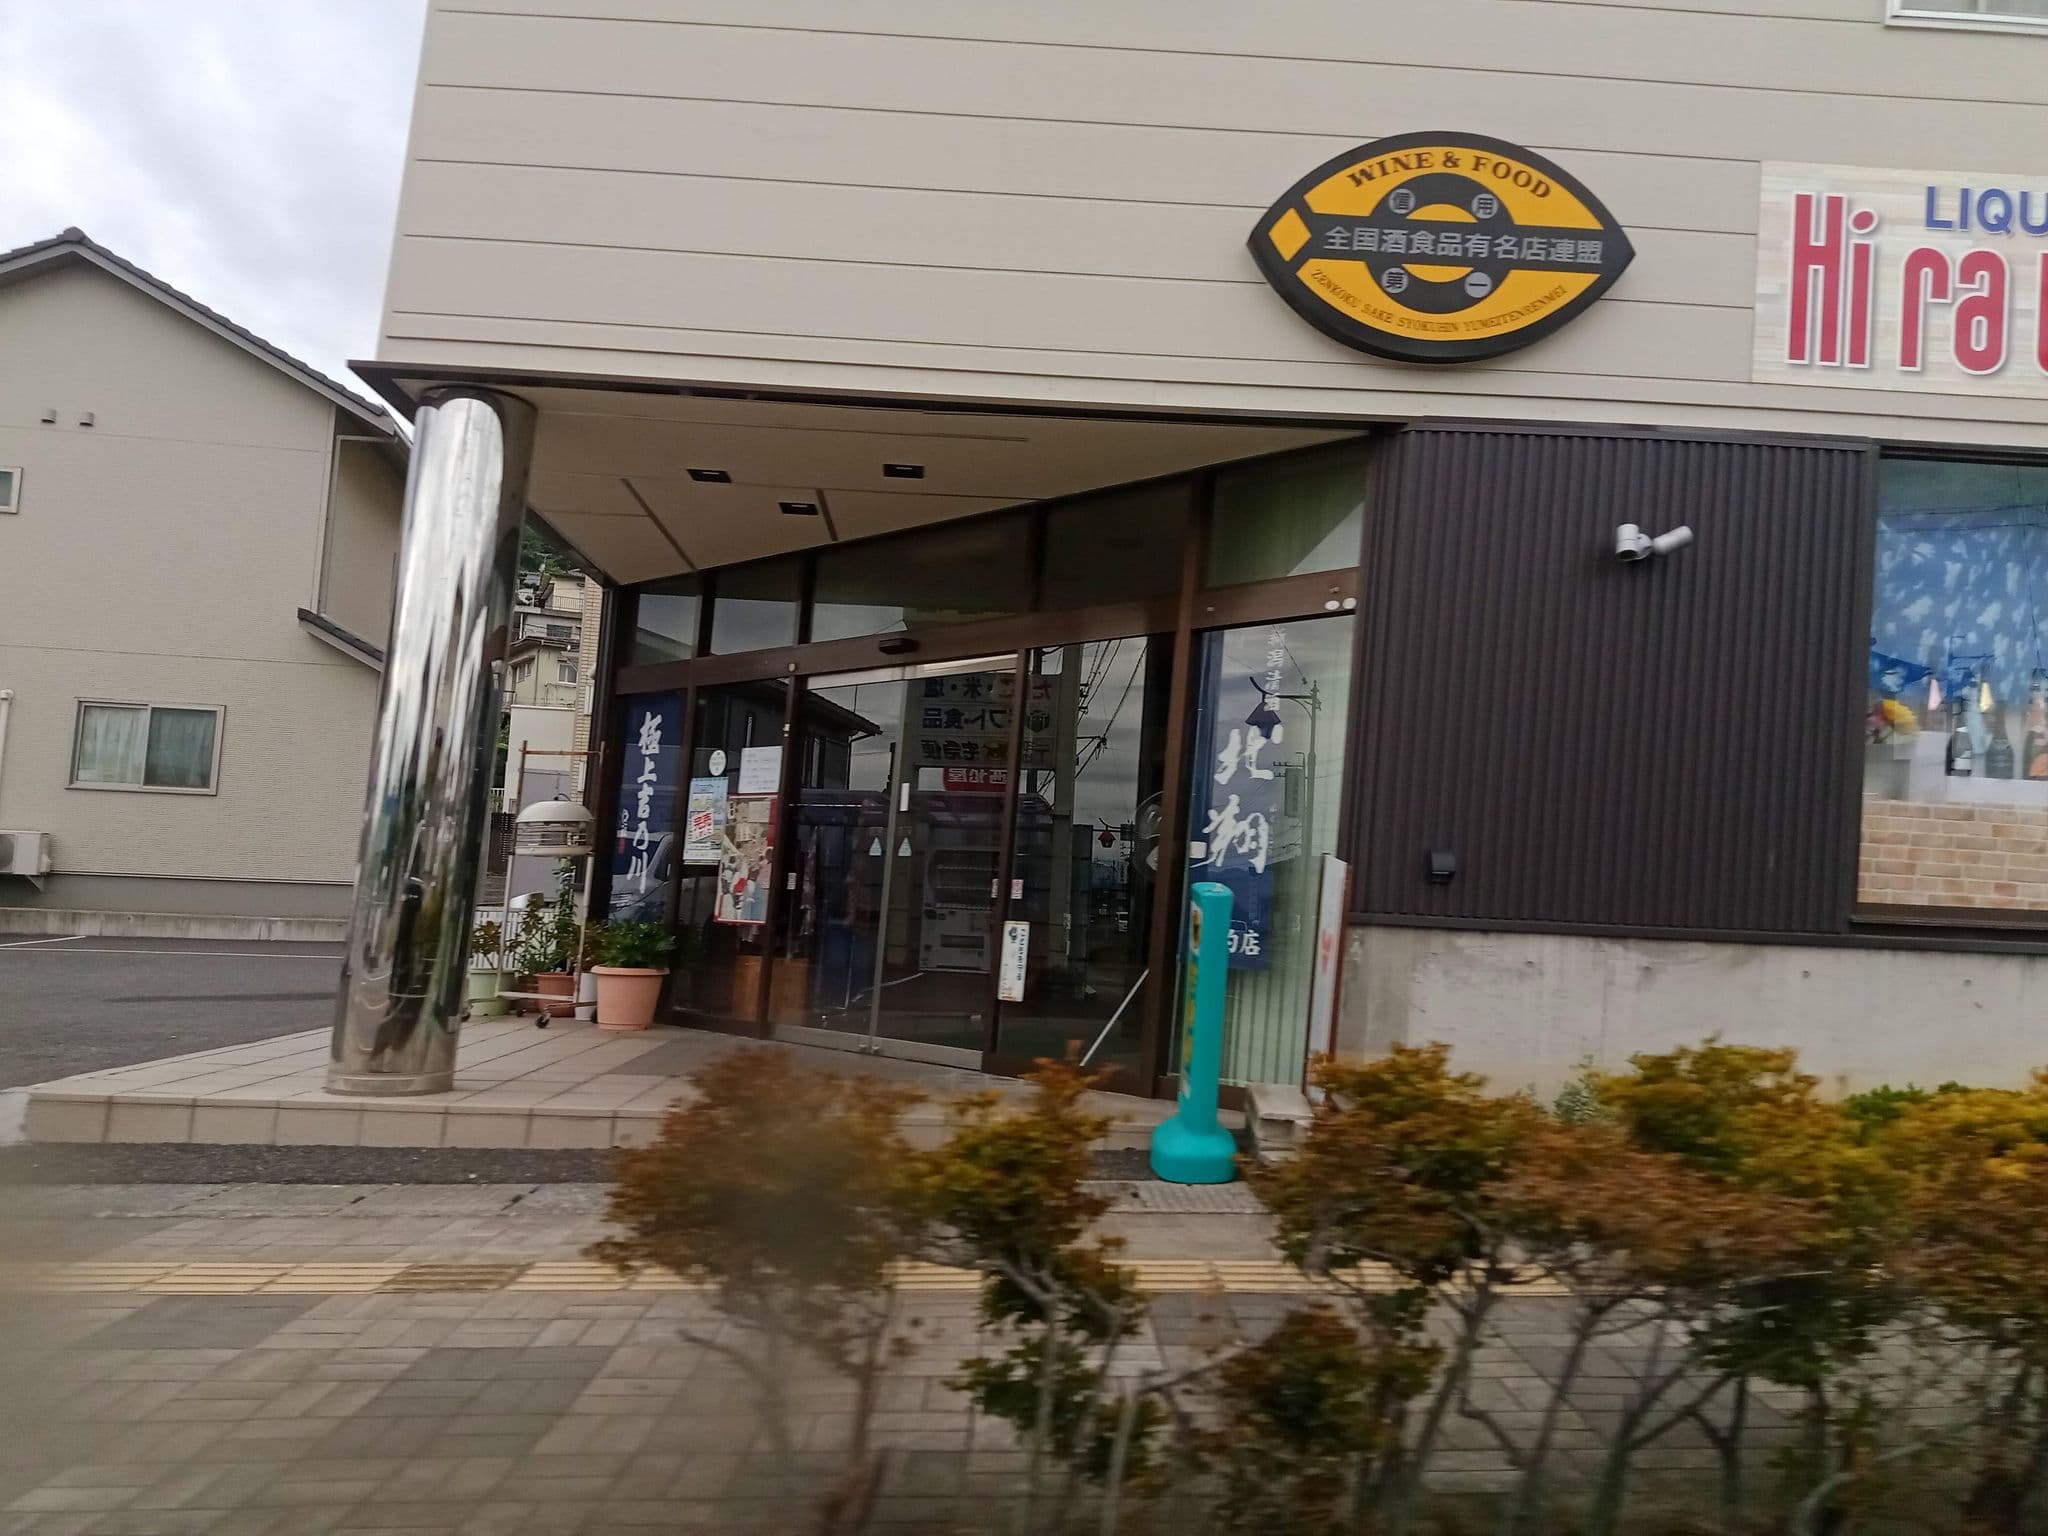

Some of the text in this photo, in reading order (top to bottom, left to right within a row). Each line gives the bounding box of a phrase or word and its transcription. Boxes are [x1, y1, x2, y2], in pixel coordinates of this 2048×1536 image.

[1346, 150, 1552, 199] WINE & FOOD
[1322, 225, 1604, 265] 全国酒食品有名店連盟
[1360, 303, 1395, 323] SAKE
